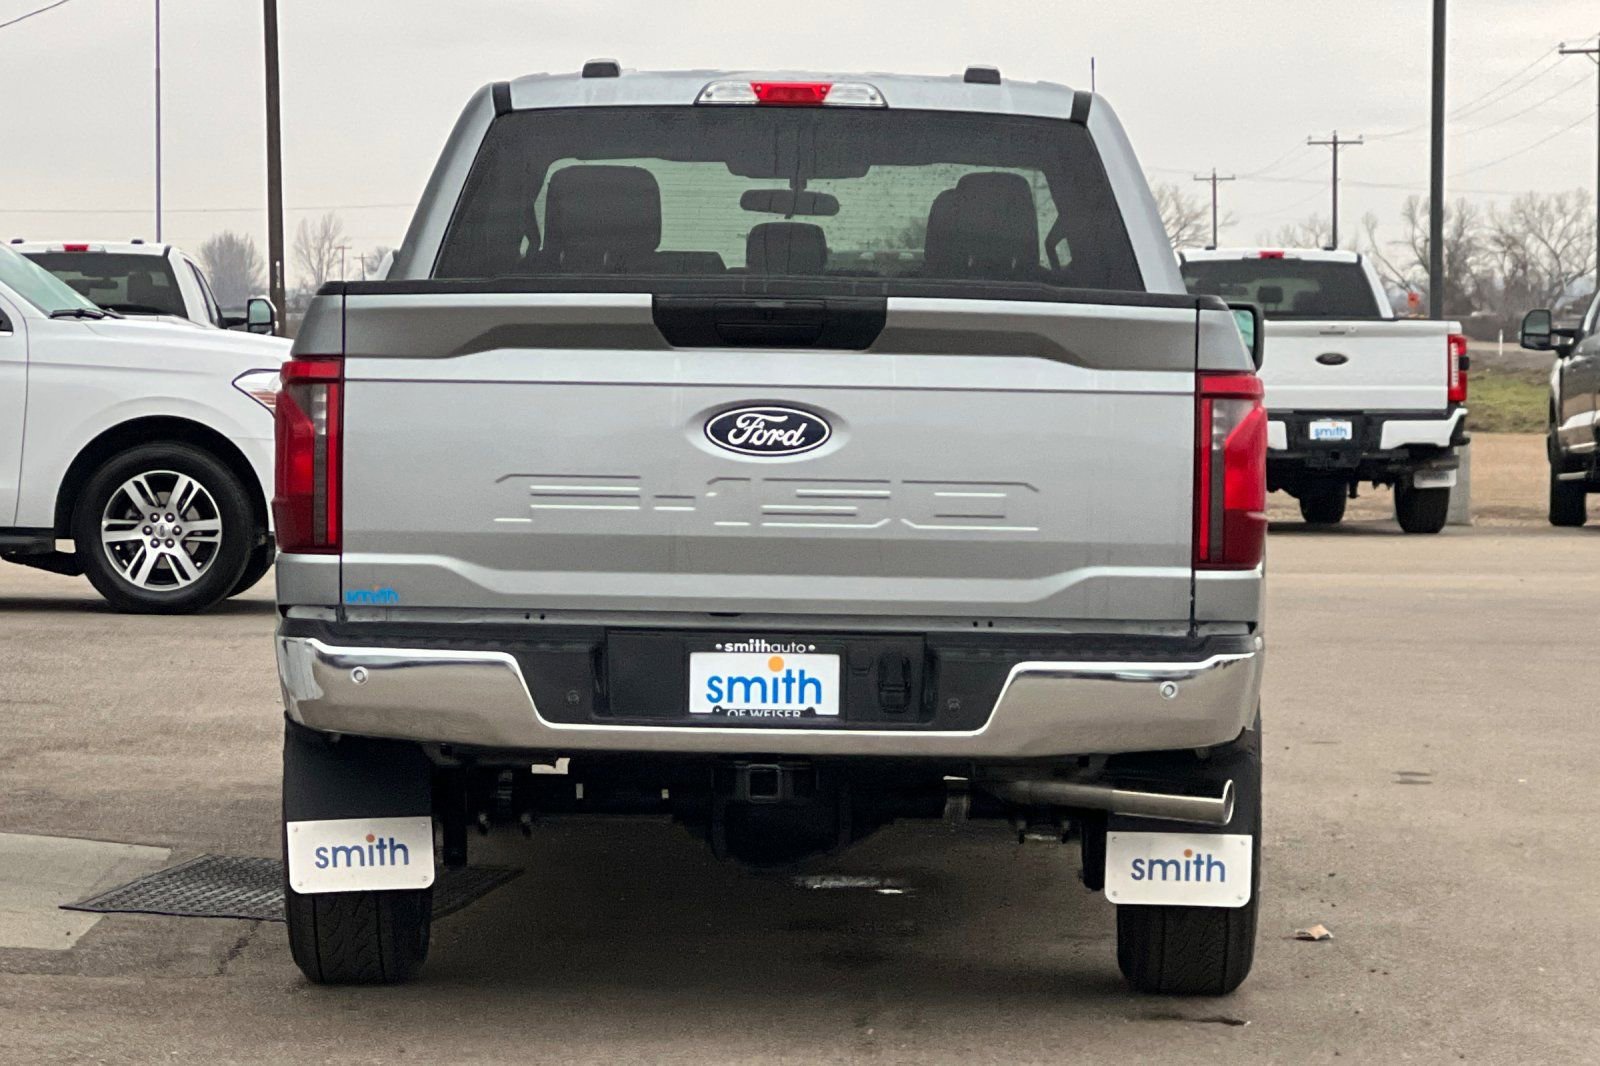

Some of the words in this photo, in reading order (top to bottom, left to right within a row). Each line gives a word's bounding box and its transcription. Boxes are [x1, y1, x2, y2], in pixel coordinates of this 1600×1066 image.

[727, 412, 808, 446] Ford
[493, 473, 1040, 532] F-150
[724, 638, 806, 653] smithauto
[706, 655, 822, 704] smith
[315, 833, 409, 869] smith
[1131, 848, 1226, 882] smith
